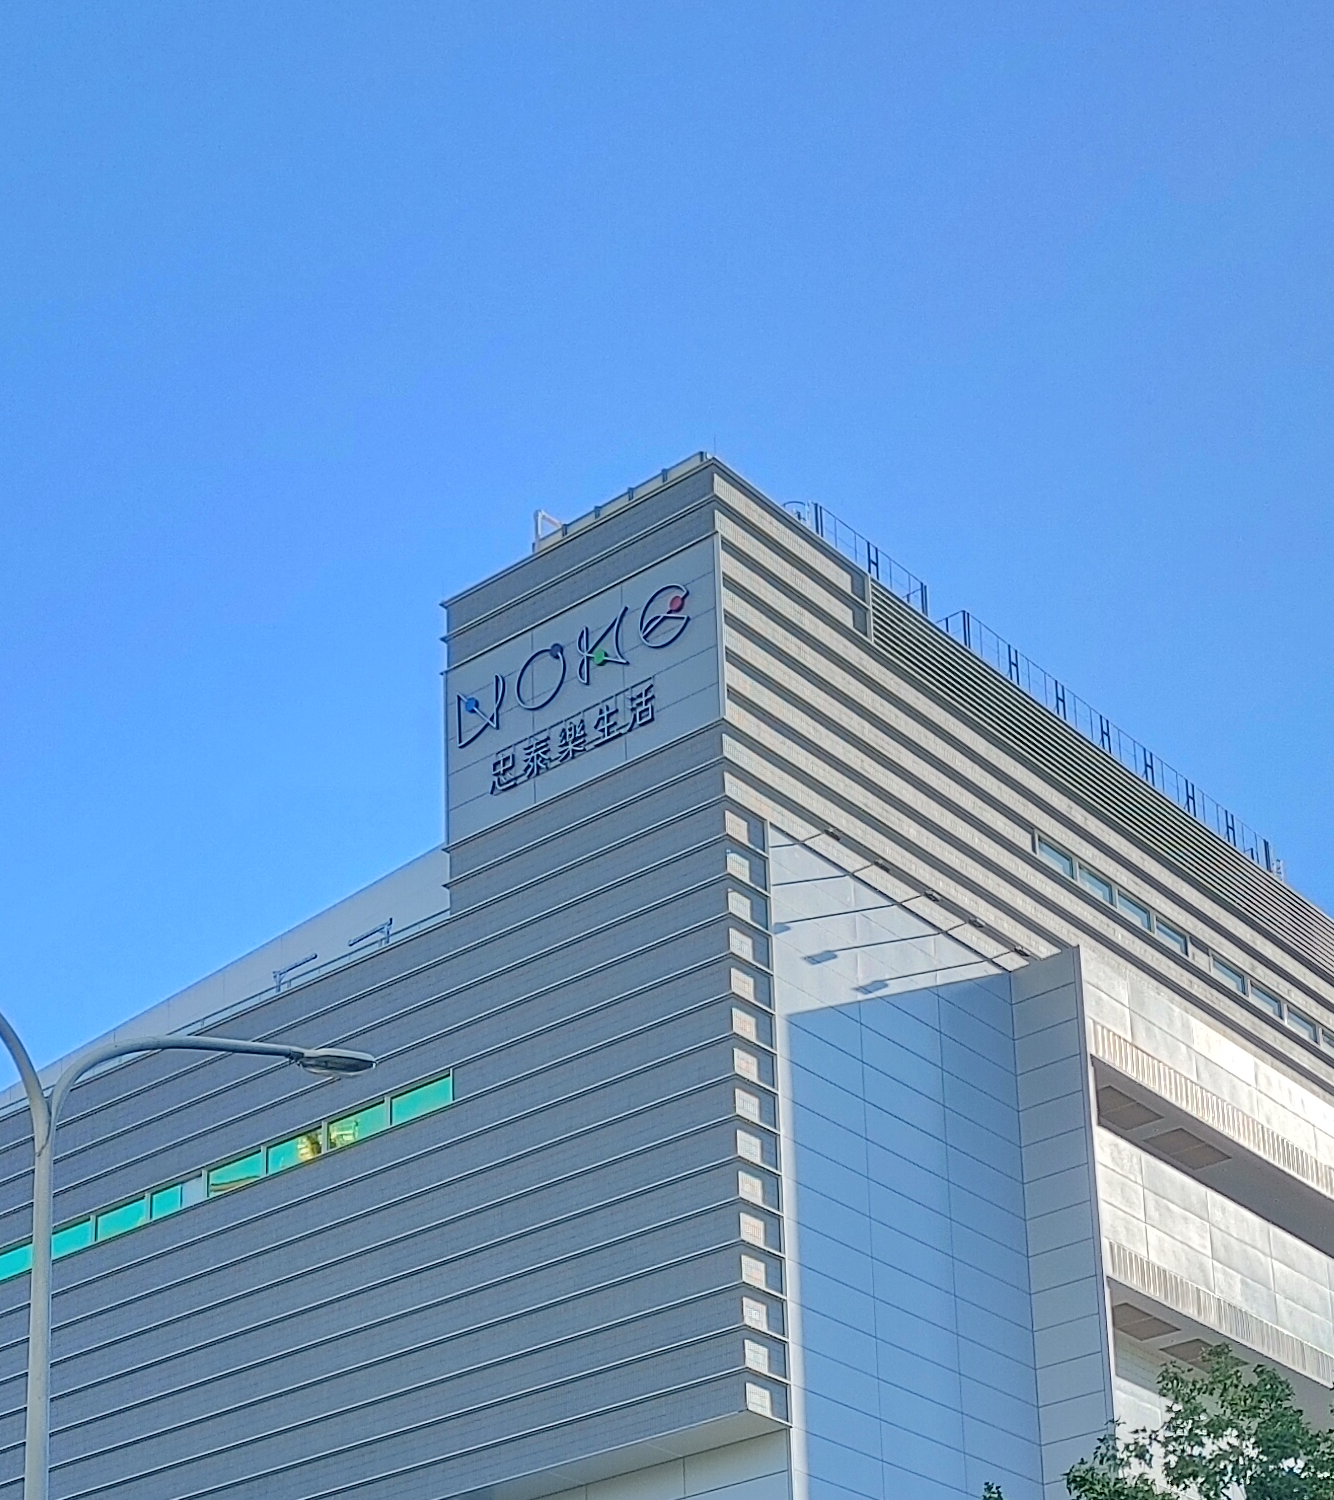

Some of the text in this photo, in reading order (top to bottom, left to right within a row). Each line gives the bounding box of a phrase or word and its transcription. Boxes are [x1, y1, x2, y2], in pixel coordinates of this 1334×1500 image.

[490, 684, 655, 795] 忠泰樂生活
